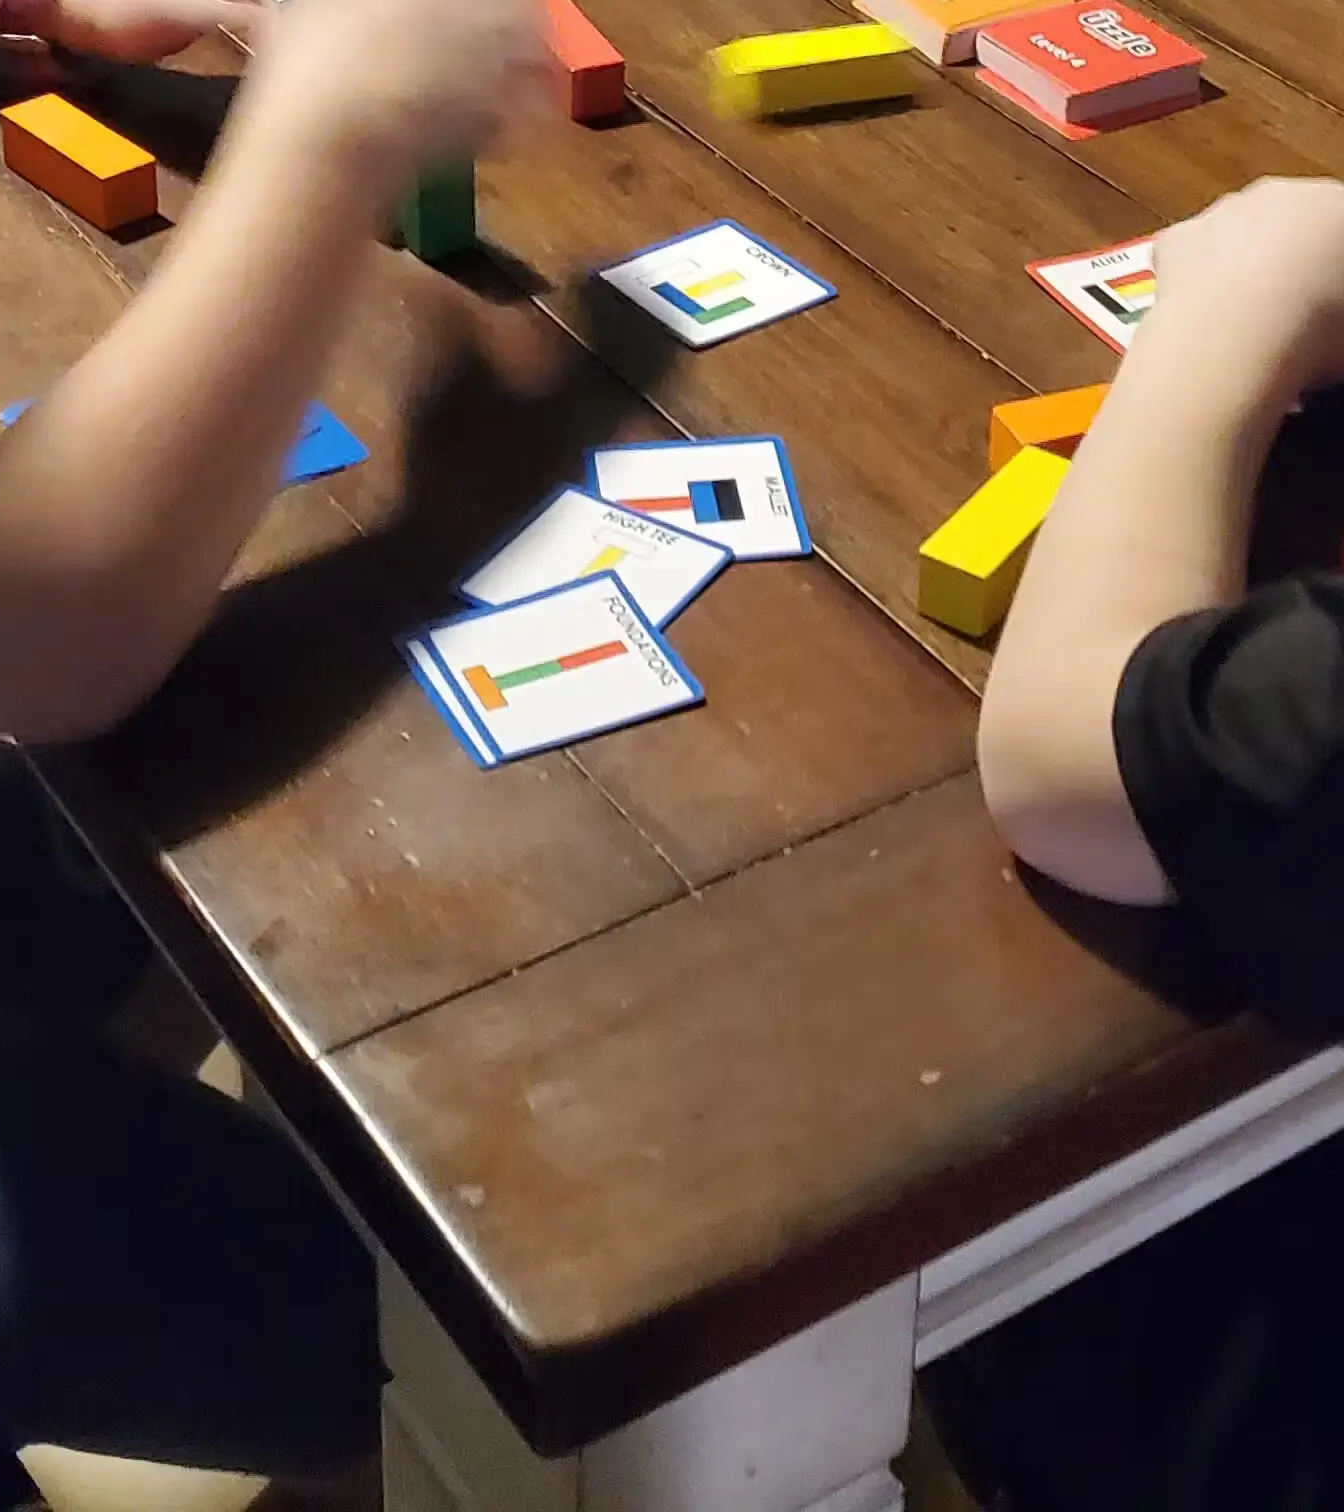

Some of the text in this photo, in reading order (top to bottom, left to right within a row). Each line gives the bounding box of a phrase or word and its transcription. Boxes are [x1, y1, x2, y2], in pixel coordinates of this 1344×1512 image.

[1028, 33, 1075, 62] Level
[746, 245, 793, 277] CROWN
[601, 595, 678, 686] FOUNDATIONS
